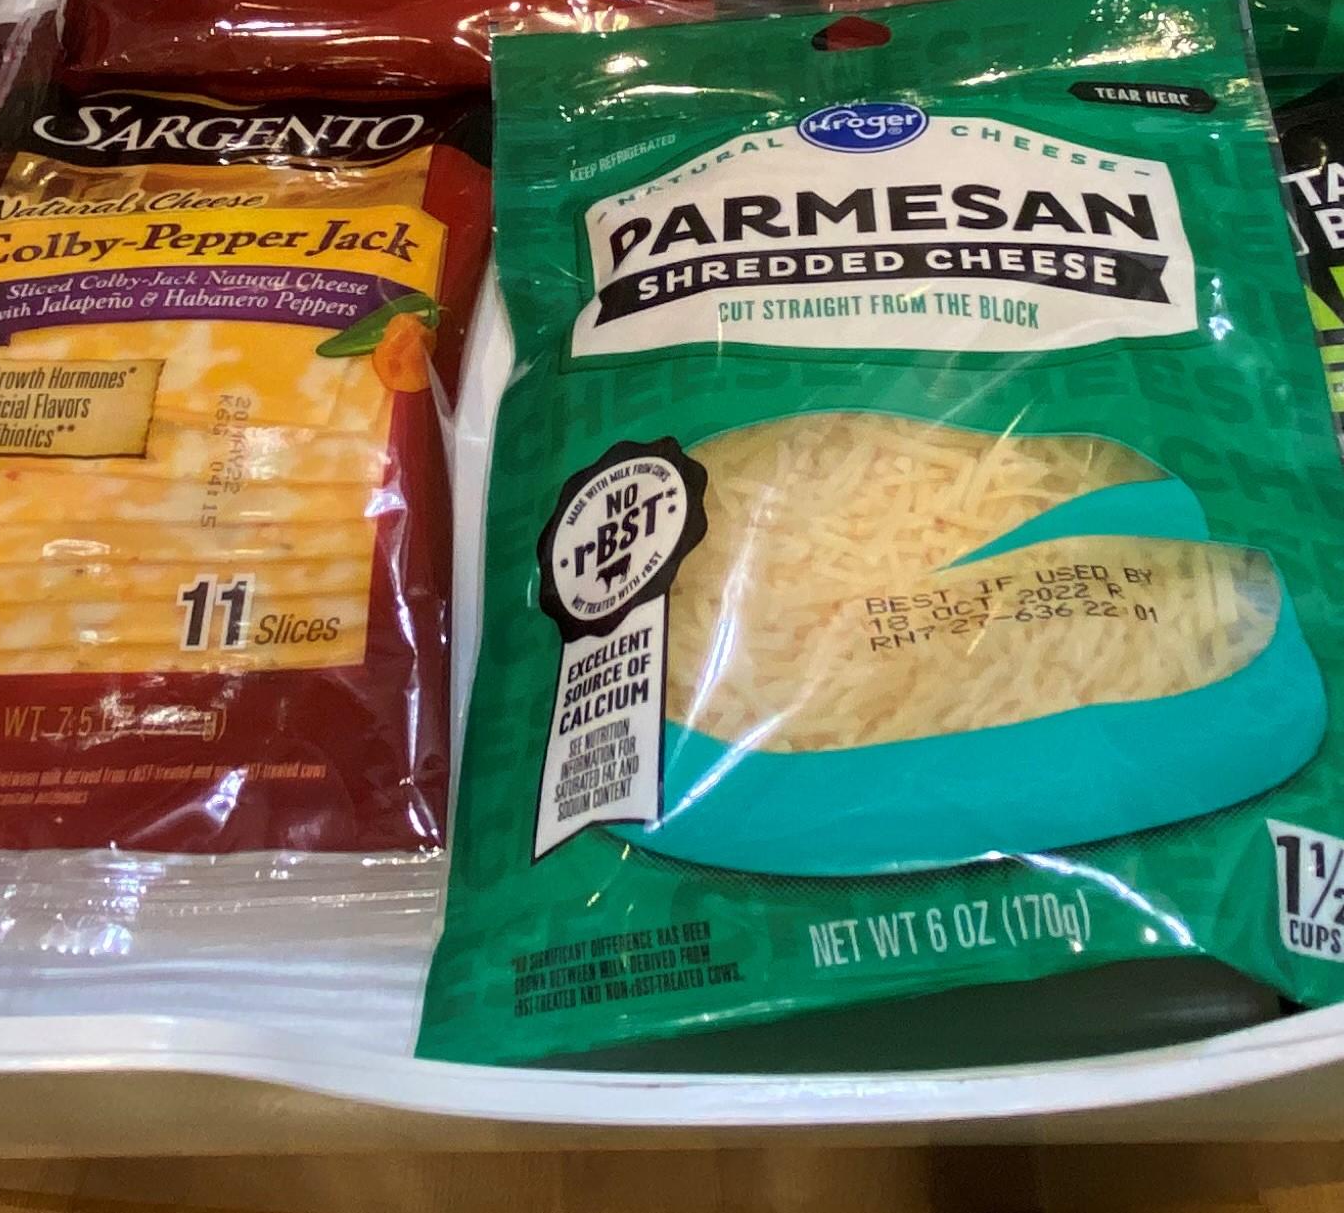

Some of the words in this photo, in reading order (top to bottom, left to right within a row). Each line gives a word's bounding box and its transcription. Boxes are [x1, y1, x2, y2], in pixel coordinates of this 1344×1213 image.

[1092, 84, 1144, 105] TEAR
[1147, 87, 1192, 108] HERE
[34, 105, 426, 153] SARGENTO
[808, 108, 920, 140] Kroger
[569, 165, 599, 183] KEEP
[598, 134, 678, 174] REFRIGERATED
[617, 137, 785, 207] NATURAL
[949, 123, 1120, 175] CHEESE
[144, 190, 265, 213] Cheese
[306, 220, 423, 263] Jack
[609, 183, 1160, 271] PARMESAN
[7, 276, 73, 301] Sliced
[79, 270, 201, 293] Colby-Jack
[208, 268, 293, 293] Natural
[298, 270, 369, 298] Cheese
[637, 251, 906, 303] SHREDDED
[930, 246, 1120, 289] CHEESE
[33, 289, 136, 320] Jalapeño
[140, 289, 160, 309] &
[163, 286, 271, 312] Habanero
[274, 290, 359, 320] Peppers
[717, 299, 758, 324] CUT
[762, 296, 865, 323] STRAIGHT
[869, 291, 930, 317] FROM
[933, 291, 975, 321] THE
[976, 294, 1042, 329] BLOCK
[32, 393, 93, 420] Flavors
[565, 501, 587, 527] MADE
[584, 476, 609, 502] WITH
[608, 465, 632, 485] MILK
[631, 462, 653, 476] FROM
[605, 482, 640, 520] NO
[571, 593, 587, 614] NOT
[583, 596, 618, 616] TREATED
[616, 576, 642, 602] WITH
[640, 550, 665, 580] rBST
[865, 588, 951, 617] BEST
[975, 574, 1014, 596] IF
[1035, 563, 1112, 586] USED
[1122, 567, 1154, 586] BY
[176, 573, 253, 653] 11
[255, 610, 342, 649] Slices
[868, 614, 911, 635] 18
[931, 596, 994, 623] OCT
[1016, 582, 1092, 606] 2022
[1106, 586, 1126, 600] R
[1081, 599, 1120, 619] 22
[1133, 602, 1160, 626] 01
[566, 626, 654, 686] EXCELLENT
[563, 661, 624, 709] SOURCE
[627, 652, 652, 678] OF
[558, 677, 650, 736] CALCIUM
[559, 747, 617, 783] INFORMATION
[617, 735, 637, 758] FOR
[568, 735, 584, 760] SEE
[583, 716, 631, 753] NUTRITION
[554, 769, 601, 804] SATURATED
[601, 761, 618, 783] FAT
[618, 754, 640, 776] AND
[557, 791, 592, 823] SODIUM
[591, 776, 633, 810] CONTENT
[808, 918, 863, 969] NET
[866, 909, 920, 962] WT
[925, 908, 946, 953] 6
[955, 902, 998, 950] OZ
[1000, 888, 1092, 948] (170g)
[1286, 918, 1343, 956] CUPS
